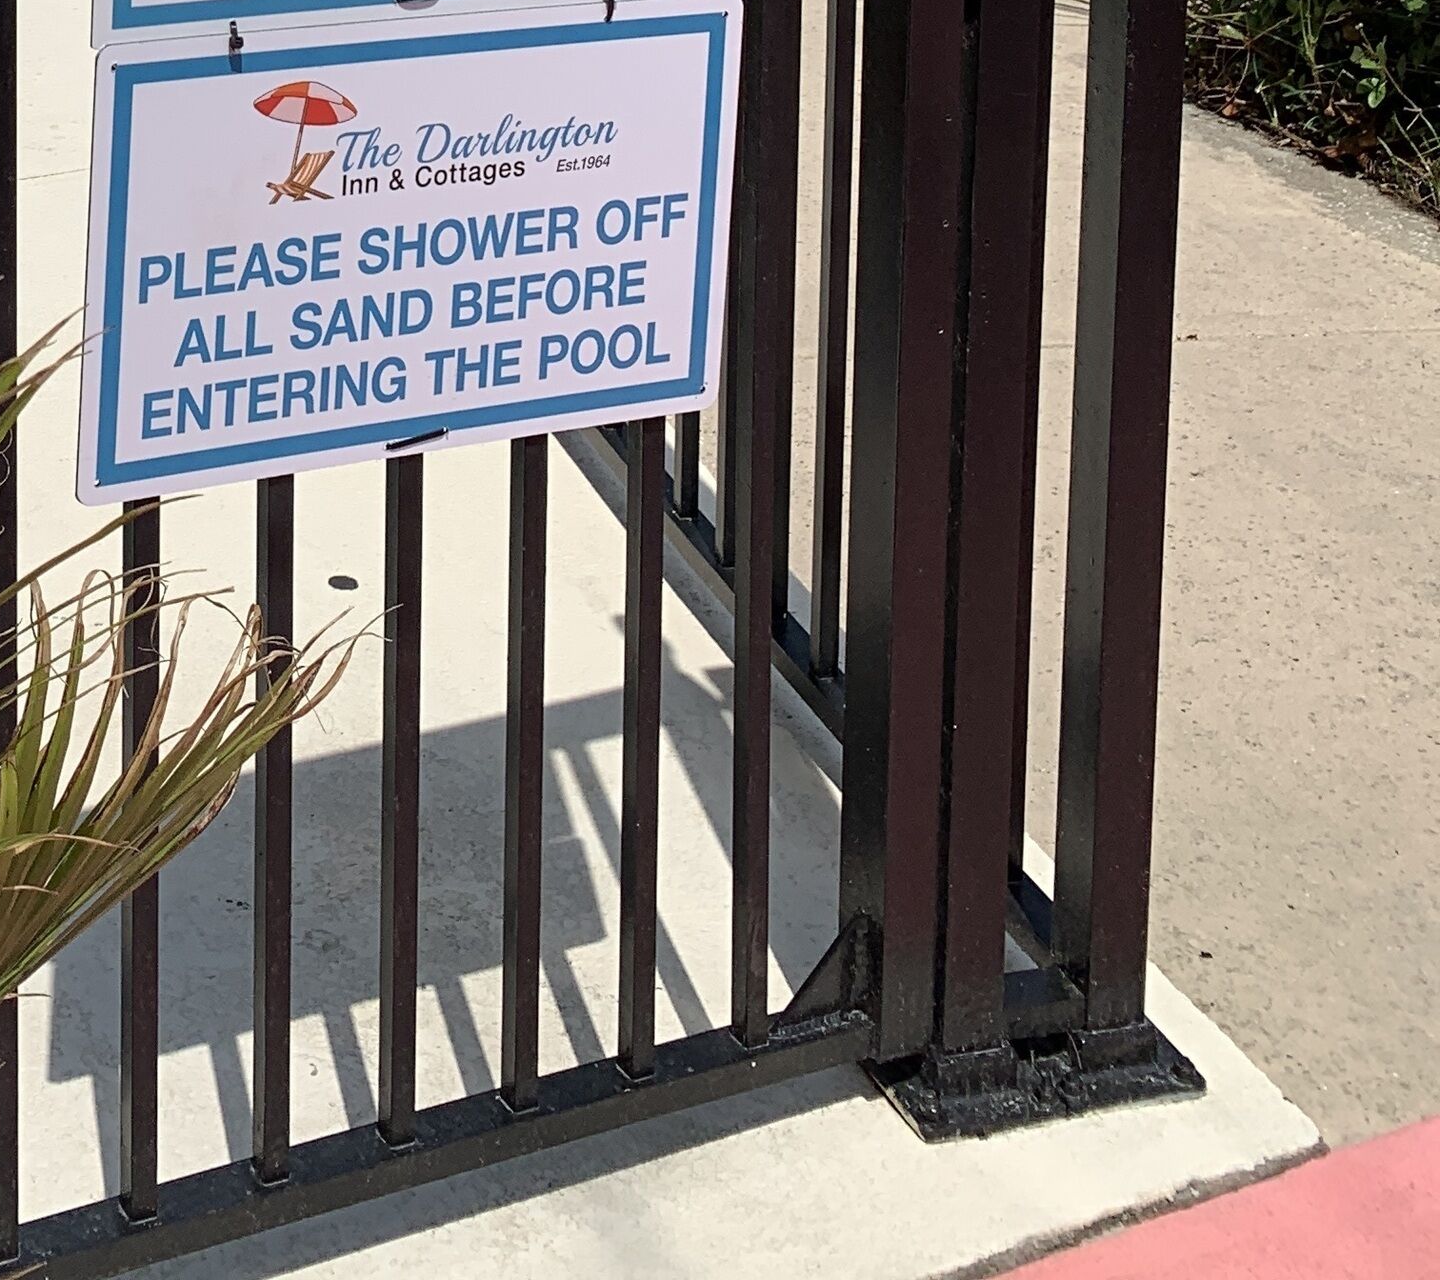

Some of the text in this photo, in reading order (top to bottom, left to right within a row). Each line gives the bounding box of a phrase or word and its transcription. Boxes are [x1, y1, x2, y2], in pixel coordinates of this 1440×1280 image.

[336, 113, 619, 173] The Darlington
[341, 160, 526, 197] Inn & Cottages
[555, 154, 611, 173] Est.1964
[139, 193, 689, 305] PLEASE SHOWER OFF
[174, 260, 647, 368] ALL SAND BEFORE
[141, 321, 671, 441] ENTERING THE POOL
